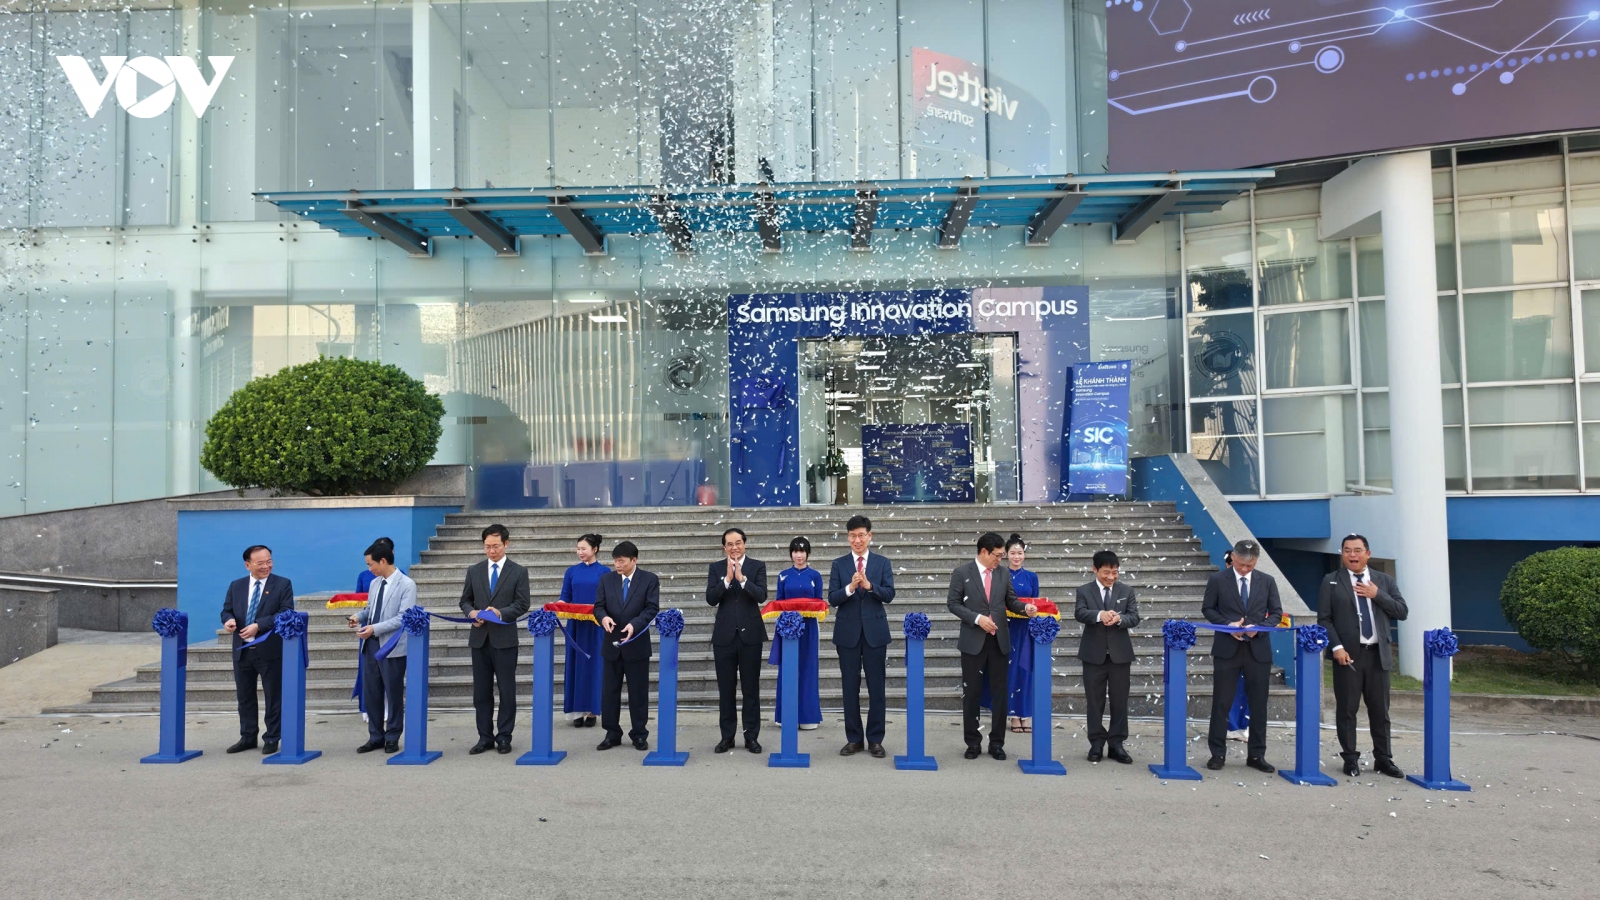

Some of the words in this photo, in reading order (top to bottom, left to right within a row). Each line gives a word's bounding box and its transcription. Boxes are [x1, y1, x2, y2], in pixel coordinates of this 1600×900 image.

[737, 304, 845, 327] Samsung
[851, 300, 972, 321] Innovation
[979, 299, 1078, 322] Campus
[1084, 427, 1113, 443] SIC
